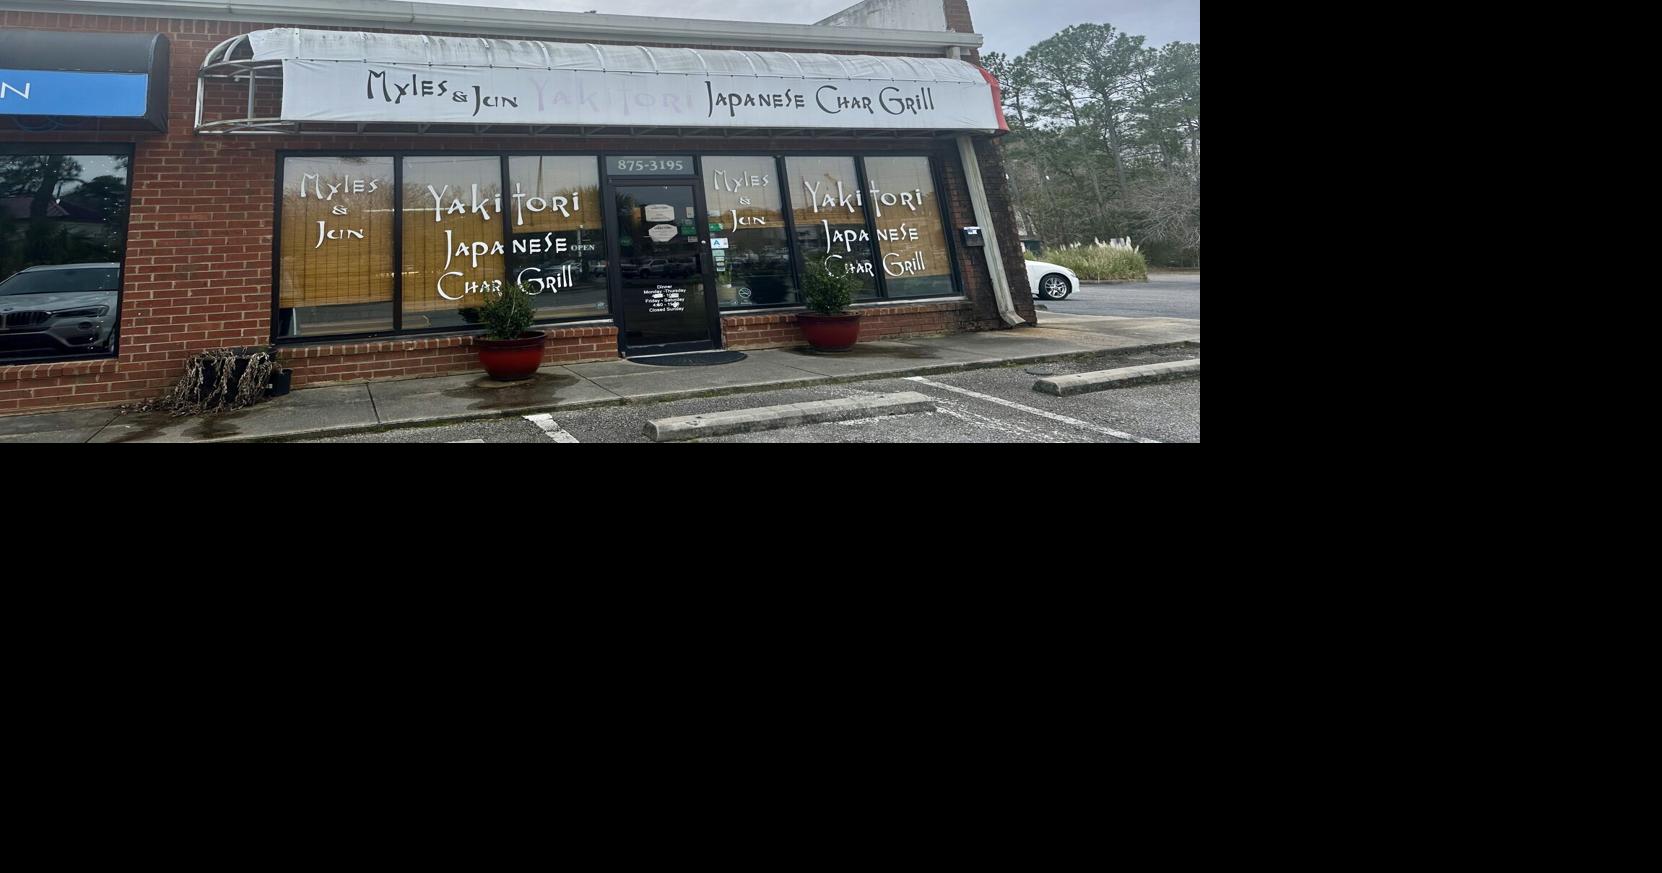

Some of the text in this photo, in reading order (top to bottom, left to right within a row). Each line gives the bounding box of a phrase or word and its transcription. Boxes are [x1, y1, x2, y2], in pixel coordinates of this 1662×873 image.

[452, 90, 468, 102] &
[617, 159, 683, 171] 875-3195
[740, 197, 751, 205] &
[332, 205, 348, 215] &
